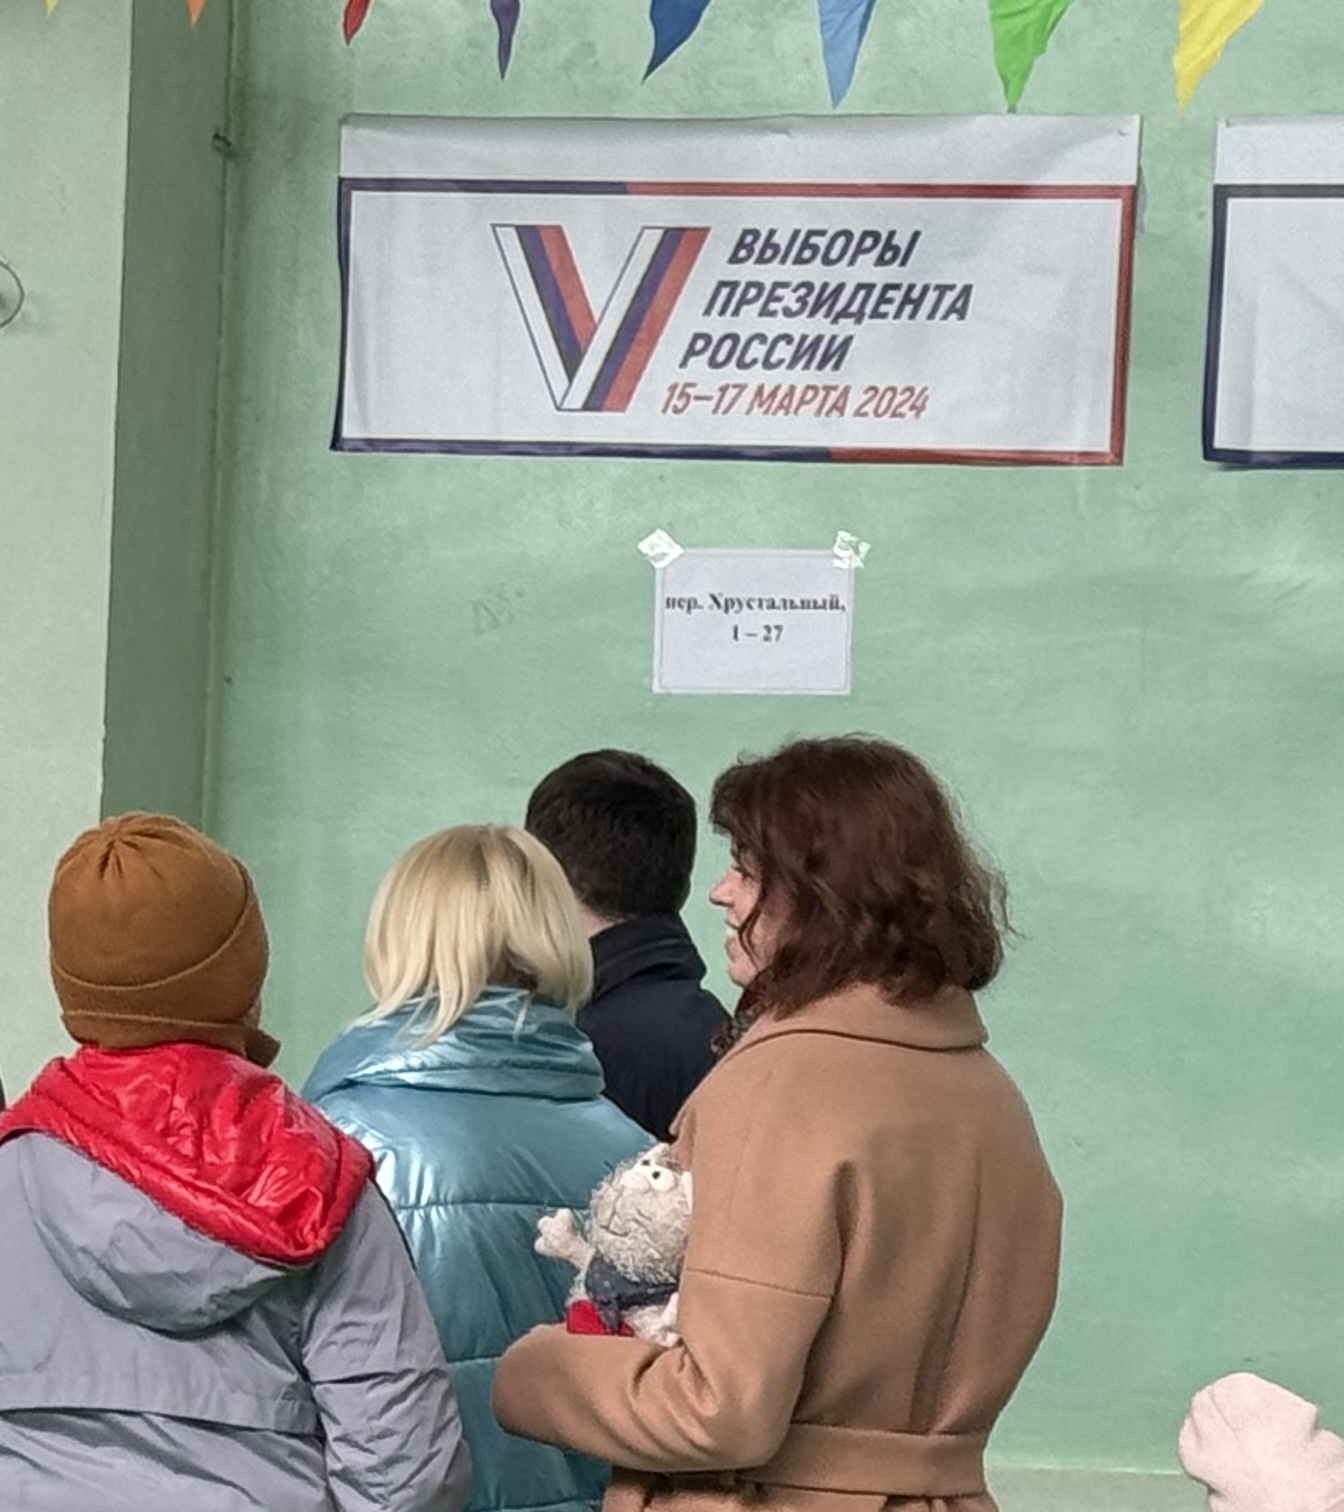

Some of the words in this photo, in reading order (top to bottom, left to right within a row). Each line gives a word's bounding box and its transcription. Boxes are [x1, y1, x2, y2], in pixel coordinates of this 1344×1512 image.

[726, 227, 922, 267] ВЫБОРЫ
[702, 280, 973, 325] ПРЕЗИДЕНТА
[678, 332, 855, 371] РОССИИ
[745, 384, 852, 417] МАРТА
[852, 385, 930, 420] 2024
[665, 596, 703, 614] пер.
[762, 624, 784, 642] 27
